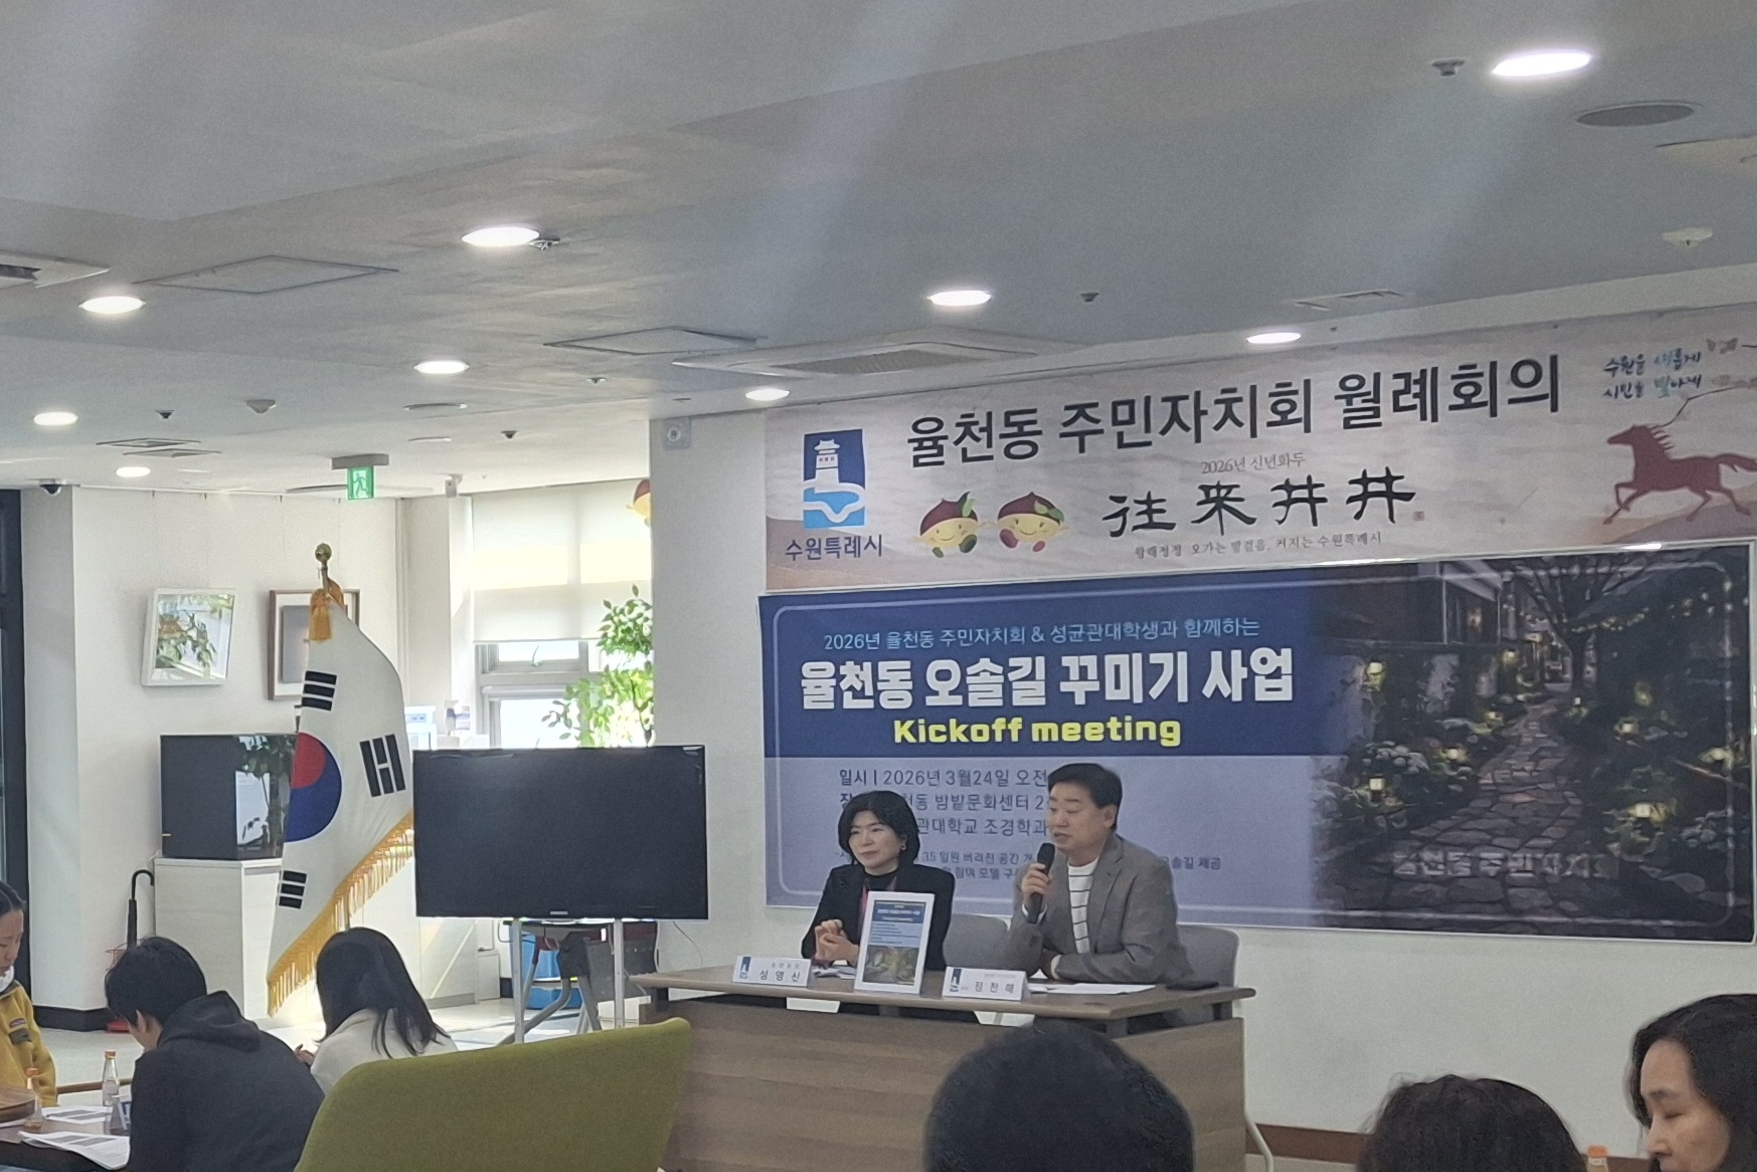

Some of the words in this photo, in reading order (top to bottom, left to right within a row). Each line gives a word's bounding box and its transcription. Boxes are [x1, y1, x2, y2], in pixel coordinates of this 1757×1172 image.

[906, 408, 1043, 468] 율천동
[1058, 378, 1313, 455] 주민자치회
[1333, 354, 1560, 430] 월례회의
[1200, 456, 1246, 475] 2026년
[1249, 451, 1306, 472] 신년화두
[784, 534, 883, 561] 수원특례시
[1192, 541, 1226, 556] 오가는
[1317, 531, 1381, 548] 수원특례시
[823, 632, 881, 650] 2026년
[886, 629, 935, 650] 율천동
[939, 625, 1026, 648] 주민자치회
[1030, 625, 1045, 644] &
[1050, 620, 1179, 644] 성균관대학생과
[1184, 616, 1261, 639] 함께하는
[800, 659, 914, 710] 율천동
[925, 655, 1047, 707] 오솔길
[1059, 650, 1189, 705] 꾸미기
[1201, 646, 1293, 702] 사업
[893, 717, 1023, 744] Kickoff
[1030, 715, 1181, 747] meeting
[839, 768, 867, 787] 일시
[882, 768, 941, 787] 2026년
[945, 768, 1010, 787] 3월24일
[1015, 768, 1048, 788] 오전
[935, 792, 1031, 812] 밤밭문화센터
[916, 817, 979, 836] 관대학교
[983, 817, 1048, 837] 조경학과
[999, 851, 1020, 864] 공간
